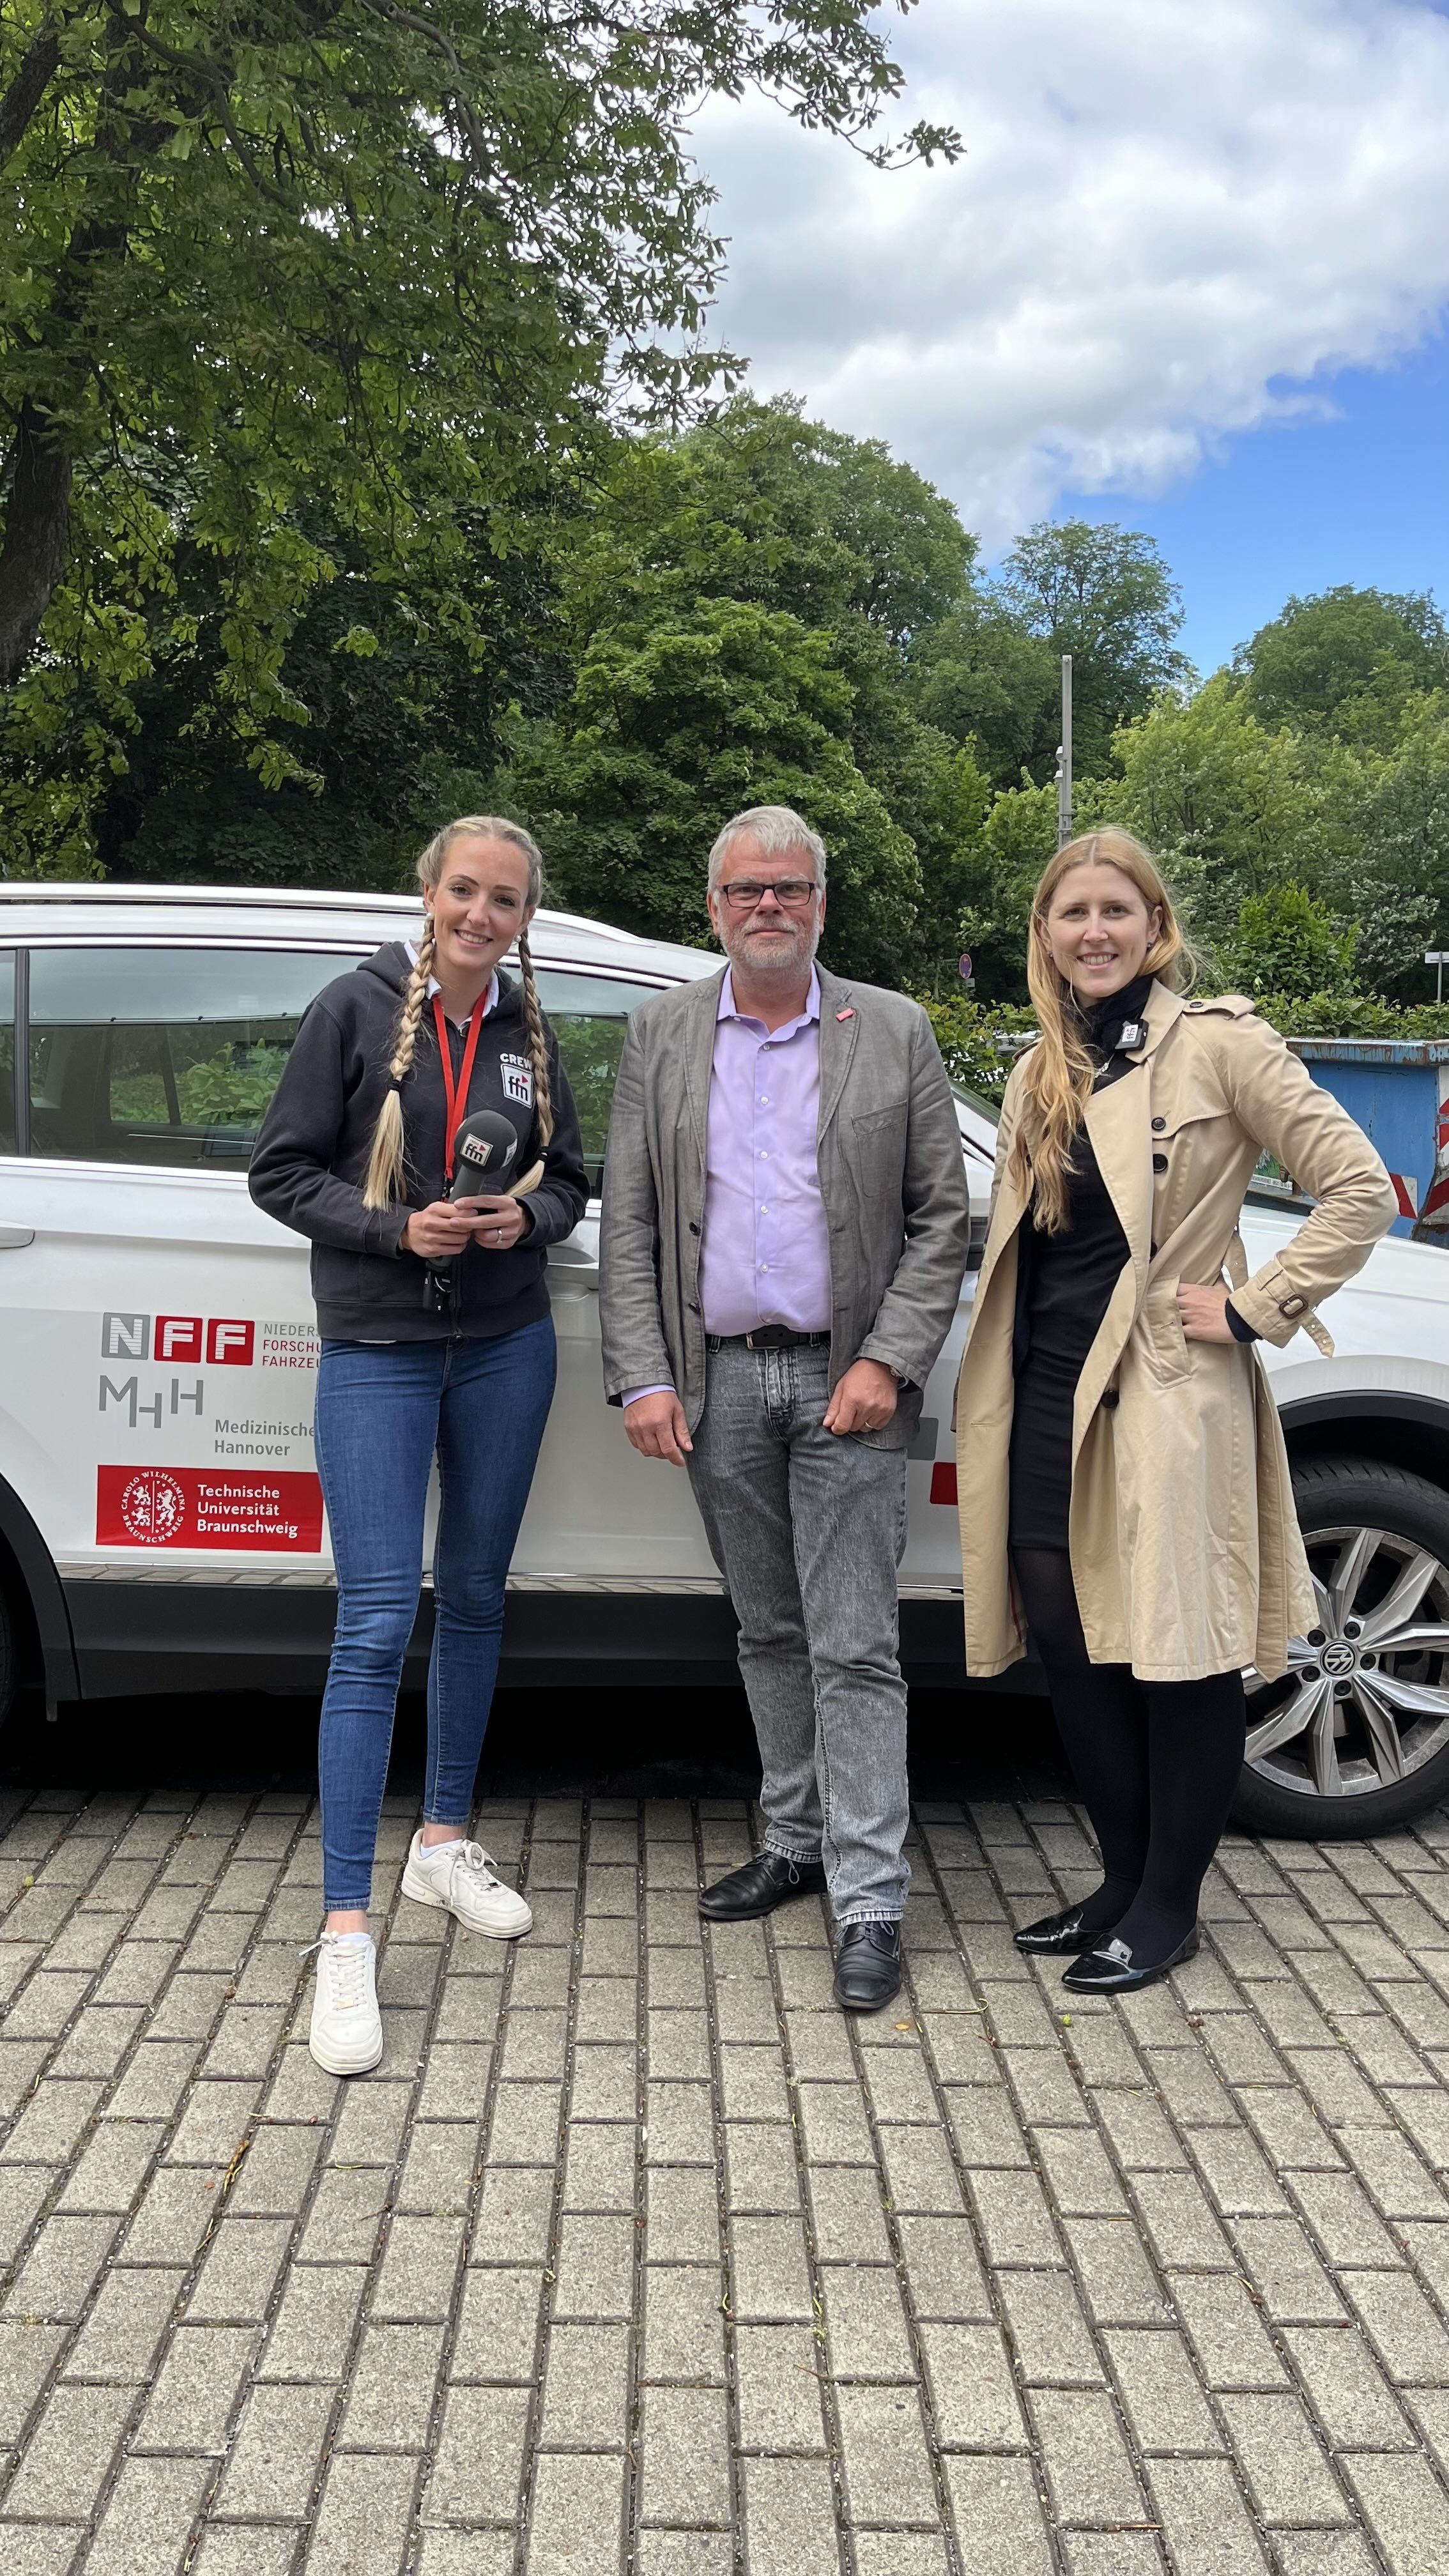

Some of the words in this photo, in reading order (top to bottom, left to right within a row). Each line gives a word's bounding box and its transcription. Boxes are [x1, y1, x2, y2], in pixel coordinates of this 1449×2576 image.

[500, 1053, 532, 1071] CREW
[508, 1076, 528, 1101] ffn
[464, 1143, 484, 1162] ffn
[109, 1317, 247, 1360] NFF
[264, 1323, 319, 1337] NIEDER
[262, 1355, 319, 1368] FAHRZE
[215, 1419, 315, 1437] Medizinische
[215, 1439, 291, 1456] Hannover
[121, 1476, 140, 1510] CAROLO
[141, 1471, 186, 1512] WILHELMINA
[197, 1483, 280, 1499] Technische
[197, 1501, 280, 1516] Universität
[122, 1515, 184, 1543] BRAUNSCHWEIG
[197, 1519, 298, 1538] Braunschweig
